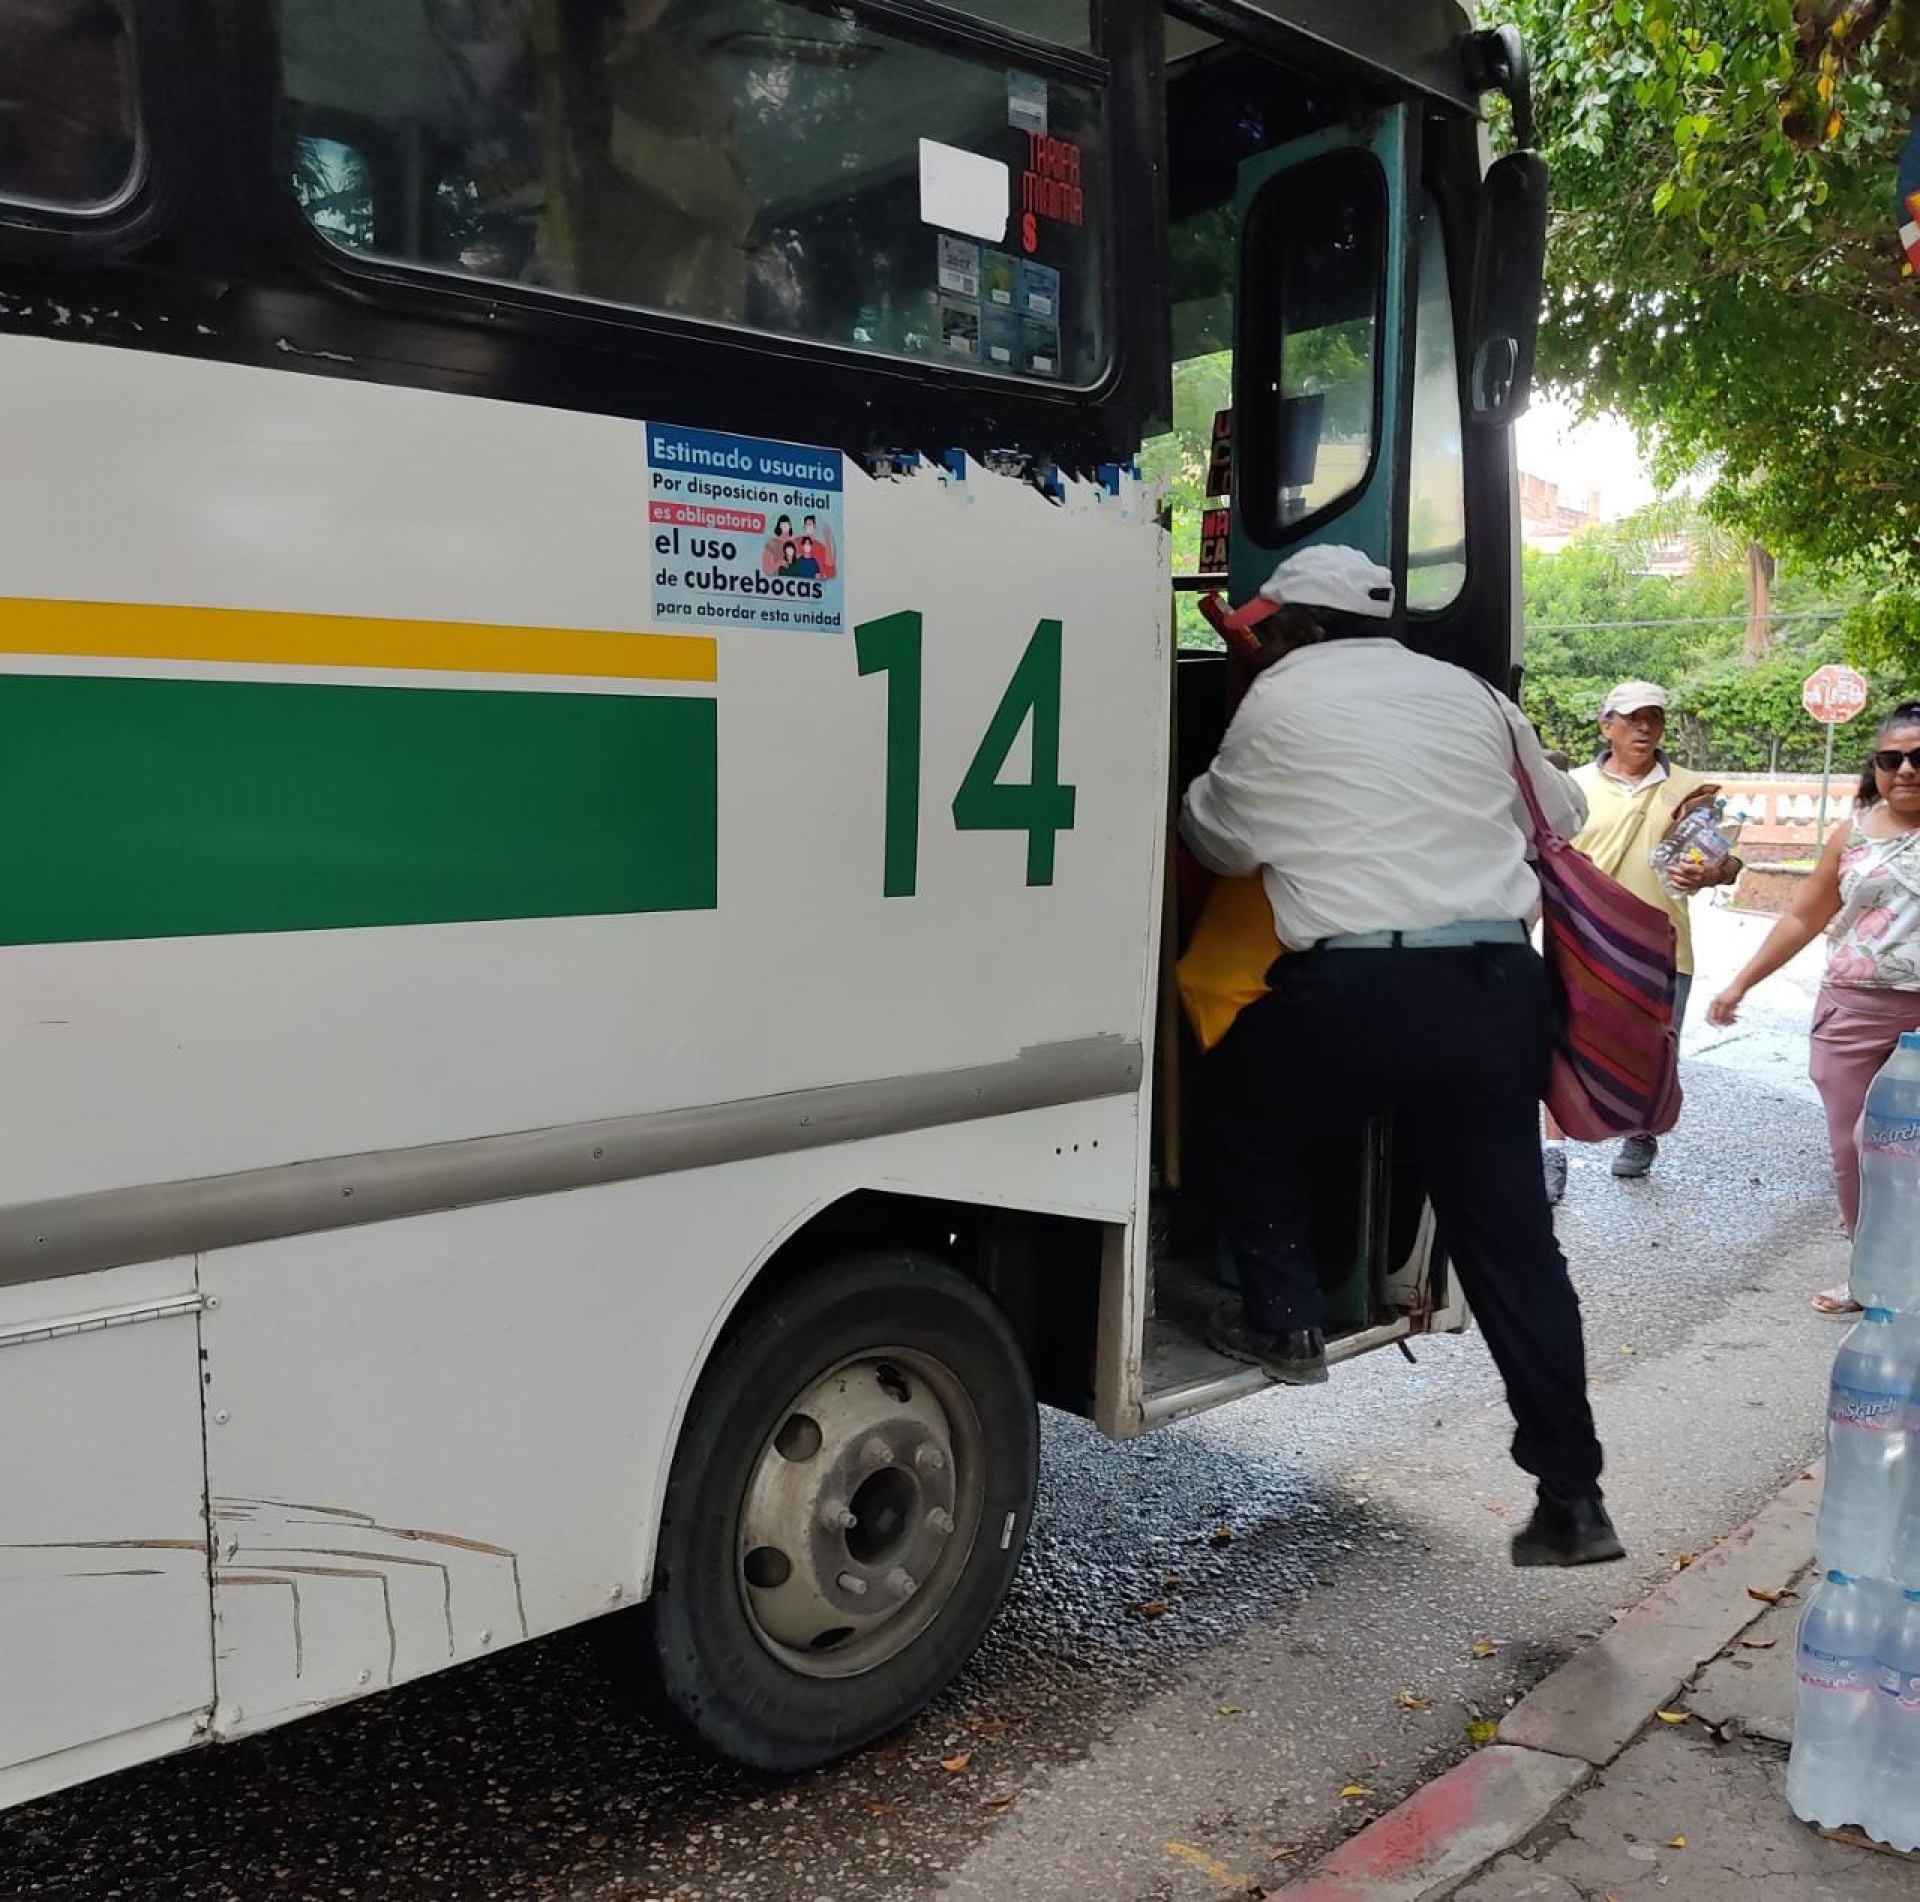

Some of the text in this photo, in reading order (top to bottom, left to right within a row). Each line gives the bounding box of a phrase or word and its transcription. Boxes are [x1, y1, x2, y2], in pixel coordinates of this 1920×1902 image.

[653, 437, 835, 483] Estimado usuario
[653, 473, 830, 510] Por disposición oficial
[653, 505, 762, 529] es obligatorio
[655, 527, 737, 560] el uso
[655, 565, 823, 599] de cubrebocas
[656, 602, 841, 626] para abordar esta unidad
[854, 609, 1076, 898] 14
